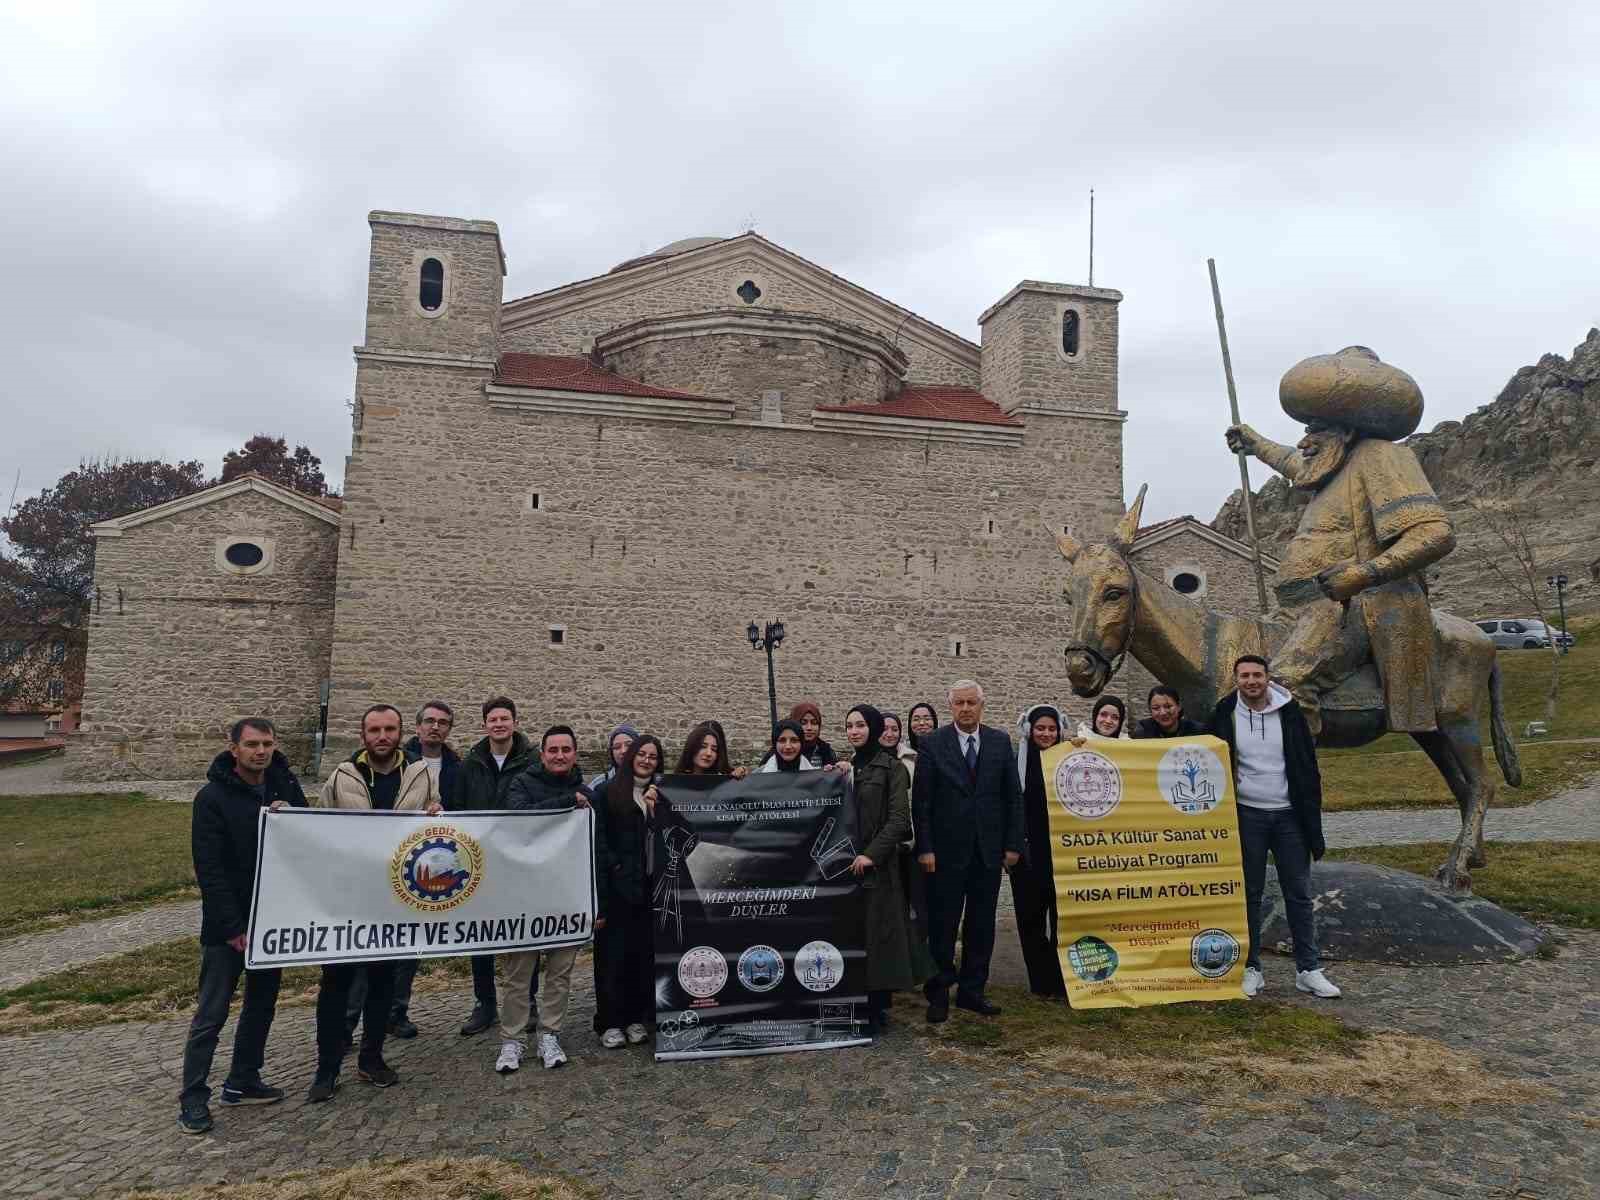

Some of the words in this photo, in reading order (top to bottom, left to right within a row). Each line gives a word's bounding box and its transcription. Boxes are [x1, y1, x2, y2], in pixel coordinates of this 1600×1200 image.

[425, 825, 456, 837] GEDİZ
[1112, 829, 1158, 845] Kültür
[1164, 827, 1207, 842] Sanat
[1210, 828, 1229, 839] ve
[1077, 854, 1145, 872] Edebiyat
[1149, 851, 1218, 870] Programı
[1117, 885, 1153, 900] FİLM
[262, 921, 328, 955] GEDİZ
[333, 919, 421, 951] TİCARET
[424, 921, 449, 946] VE
[454, 913, 526, 943] SANAYİ
[530, 912, 587, 939] ODASI
